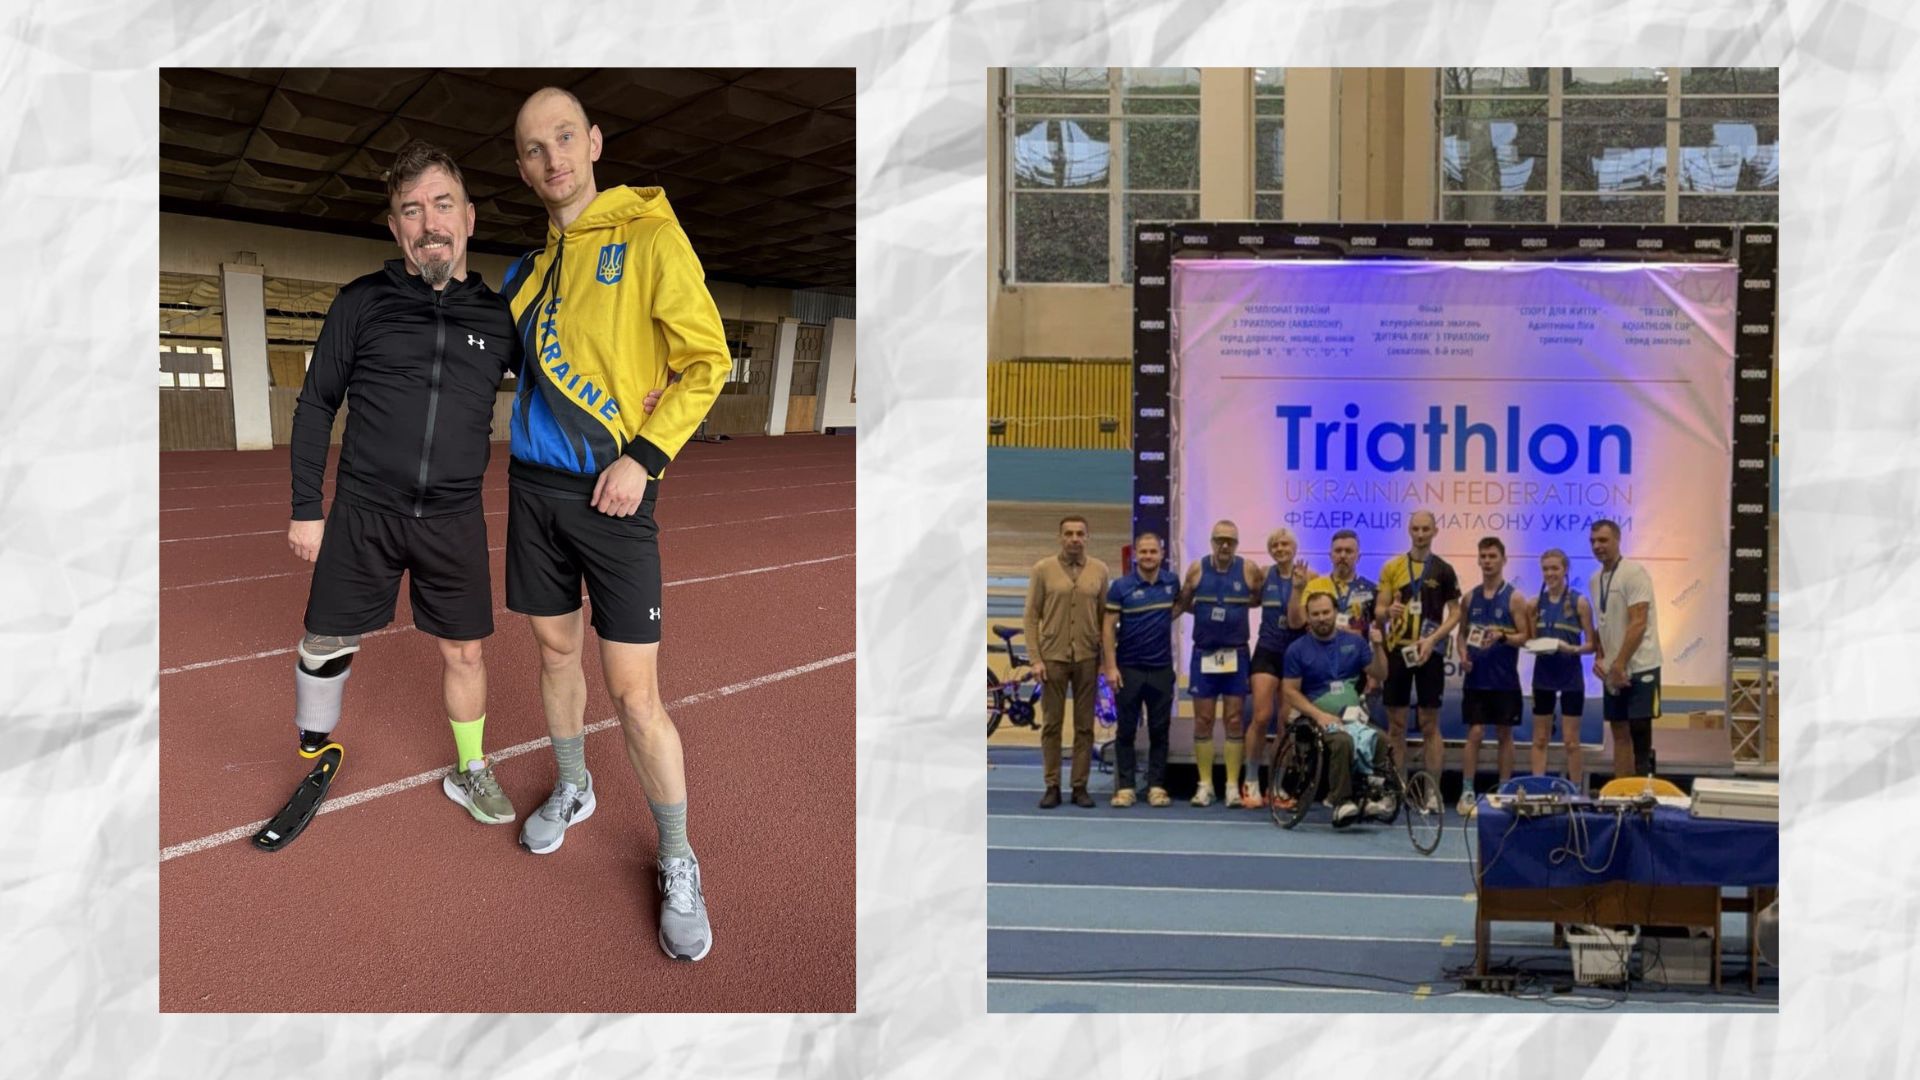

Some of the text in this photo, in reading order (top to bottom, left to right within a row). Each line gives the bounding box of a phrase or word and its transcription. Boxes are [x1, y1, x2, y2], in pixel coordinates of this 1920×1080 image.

[541, 298, 617, 420] UKRAINE
[1276, 403, 1633, 475] Triathlon
[1284, 479, 1633, 506] UKRAINIAN FEDERATION
[1284, 510, 1402, 531] ФЕДЕРАЦІЯ
[1408, 511, 1535, 532] ИАТЛОНУ
